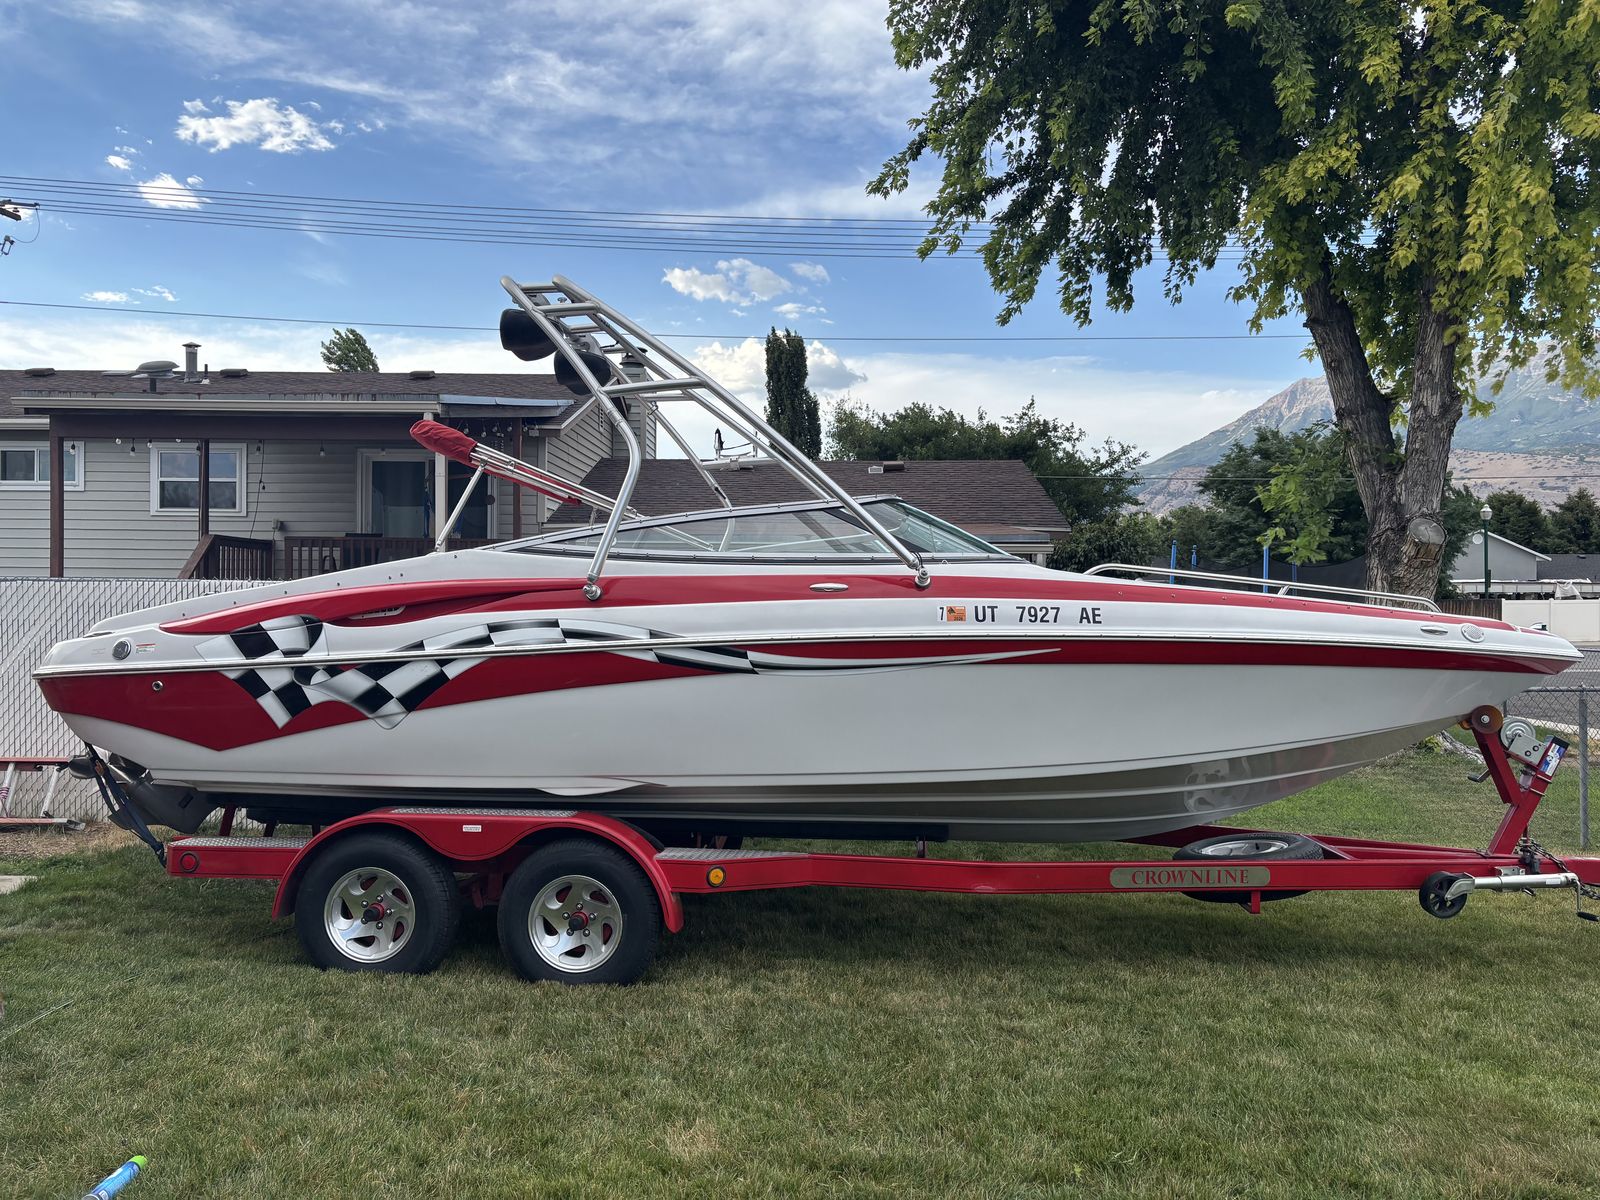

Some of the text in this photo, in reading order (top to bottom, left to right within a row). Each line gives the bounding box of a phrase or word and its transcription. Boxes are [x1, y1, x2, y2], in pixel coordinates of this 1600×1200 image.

[939, 606, 944, 621] 7
[974, 605, 998, 623] UT
[1016, 606, 1060, 623] 7927
[1079, 607, 1102, 624] AE
[1131, 869, 1249, 885] CROWNLINE
